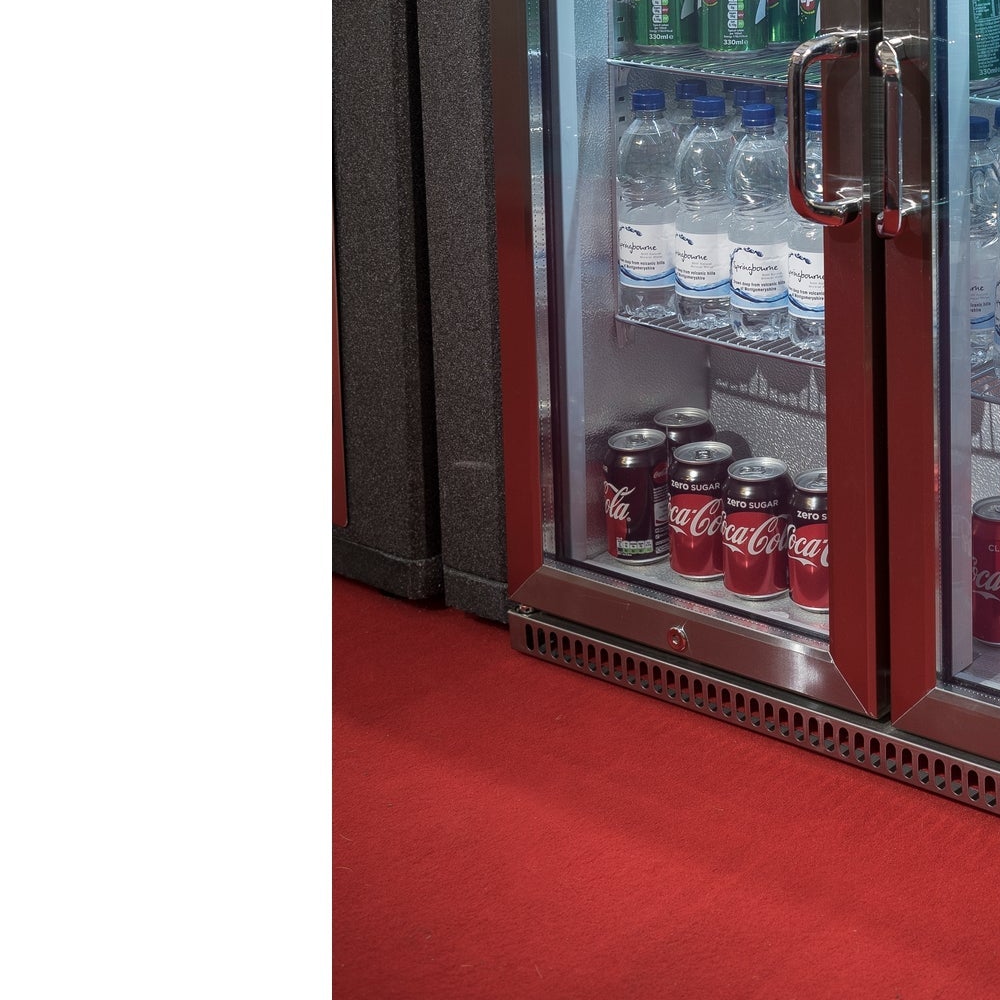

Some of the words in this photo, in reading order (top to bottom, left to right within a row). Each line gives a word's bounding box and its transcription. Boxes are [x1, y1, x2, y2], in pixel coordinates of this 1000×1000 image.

[671, 480, 689, 491] zero
[690, 482, 720, 491] SUGAR
[727, 498, 747, 509] zero
[748, 500, 779, 510] SUGAR
[796, 510, 820, 520] zero
